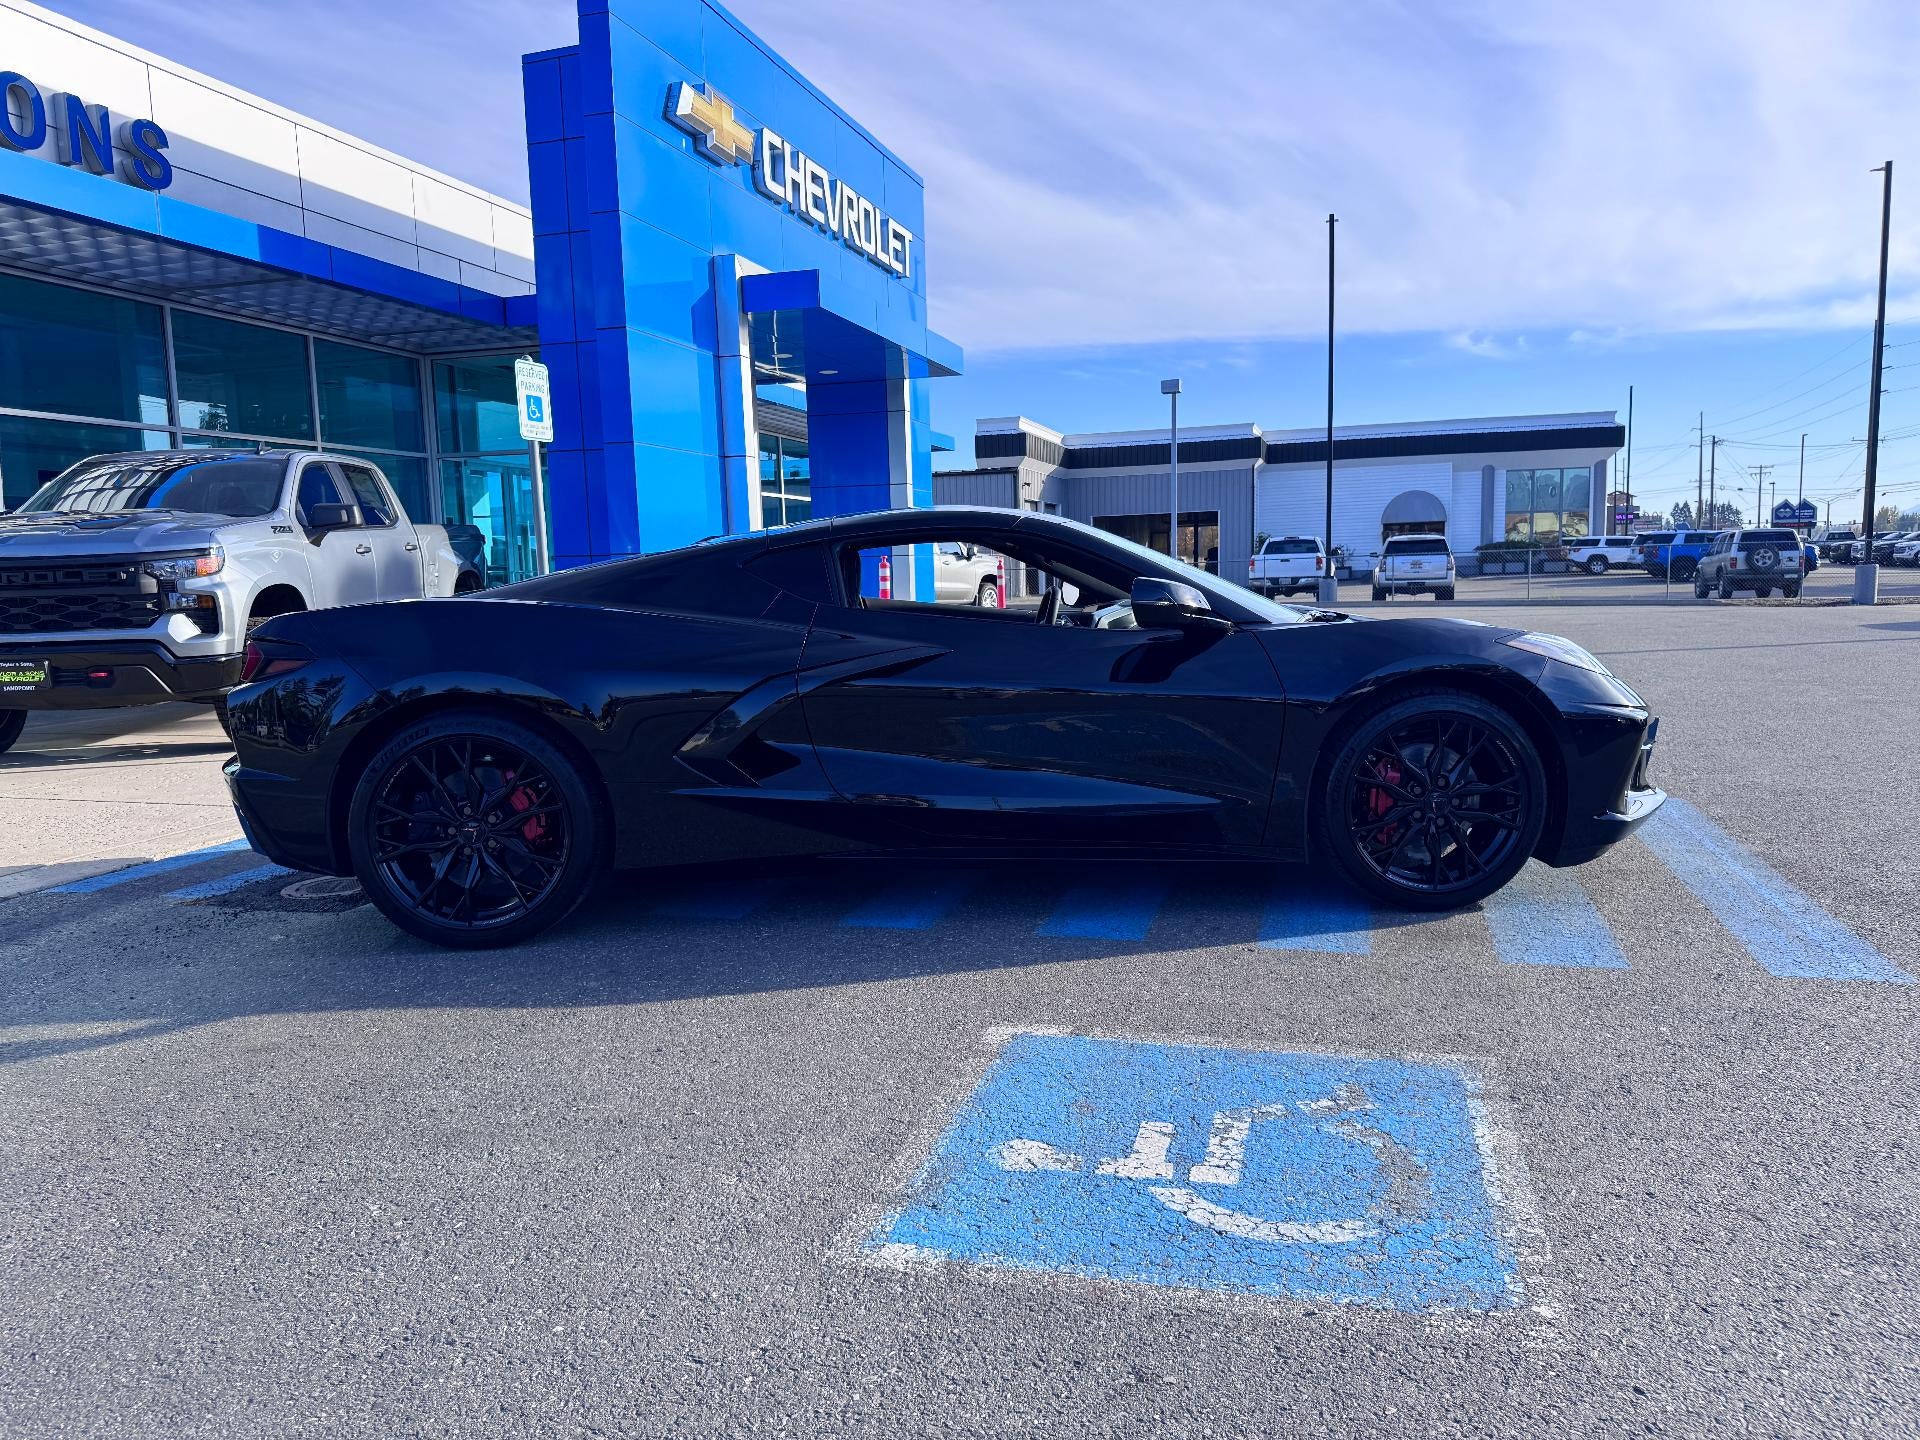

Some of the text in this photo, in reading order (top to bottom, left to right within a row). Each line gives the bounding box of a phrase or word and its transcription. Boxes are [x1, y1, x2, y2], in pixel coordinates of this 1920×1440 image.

[0, 71, 172, 190] ONS
[761, 127, 913, 278] CHEVROLET
[519, 366, 545, 381] RESERVED
[521, 380, 545, 393] PARKING
